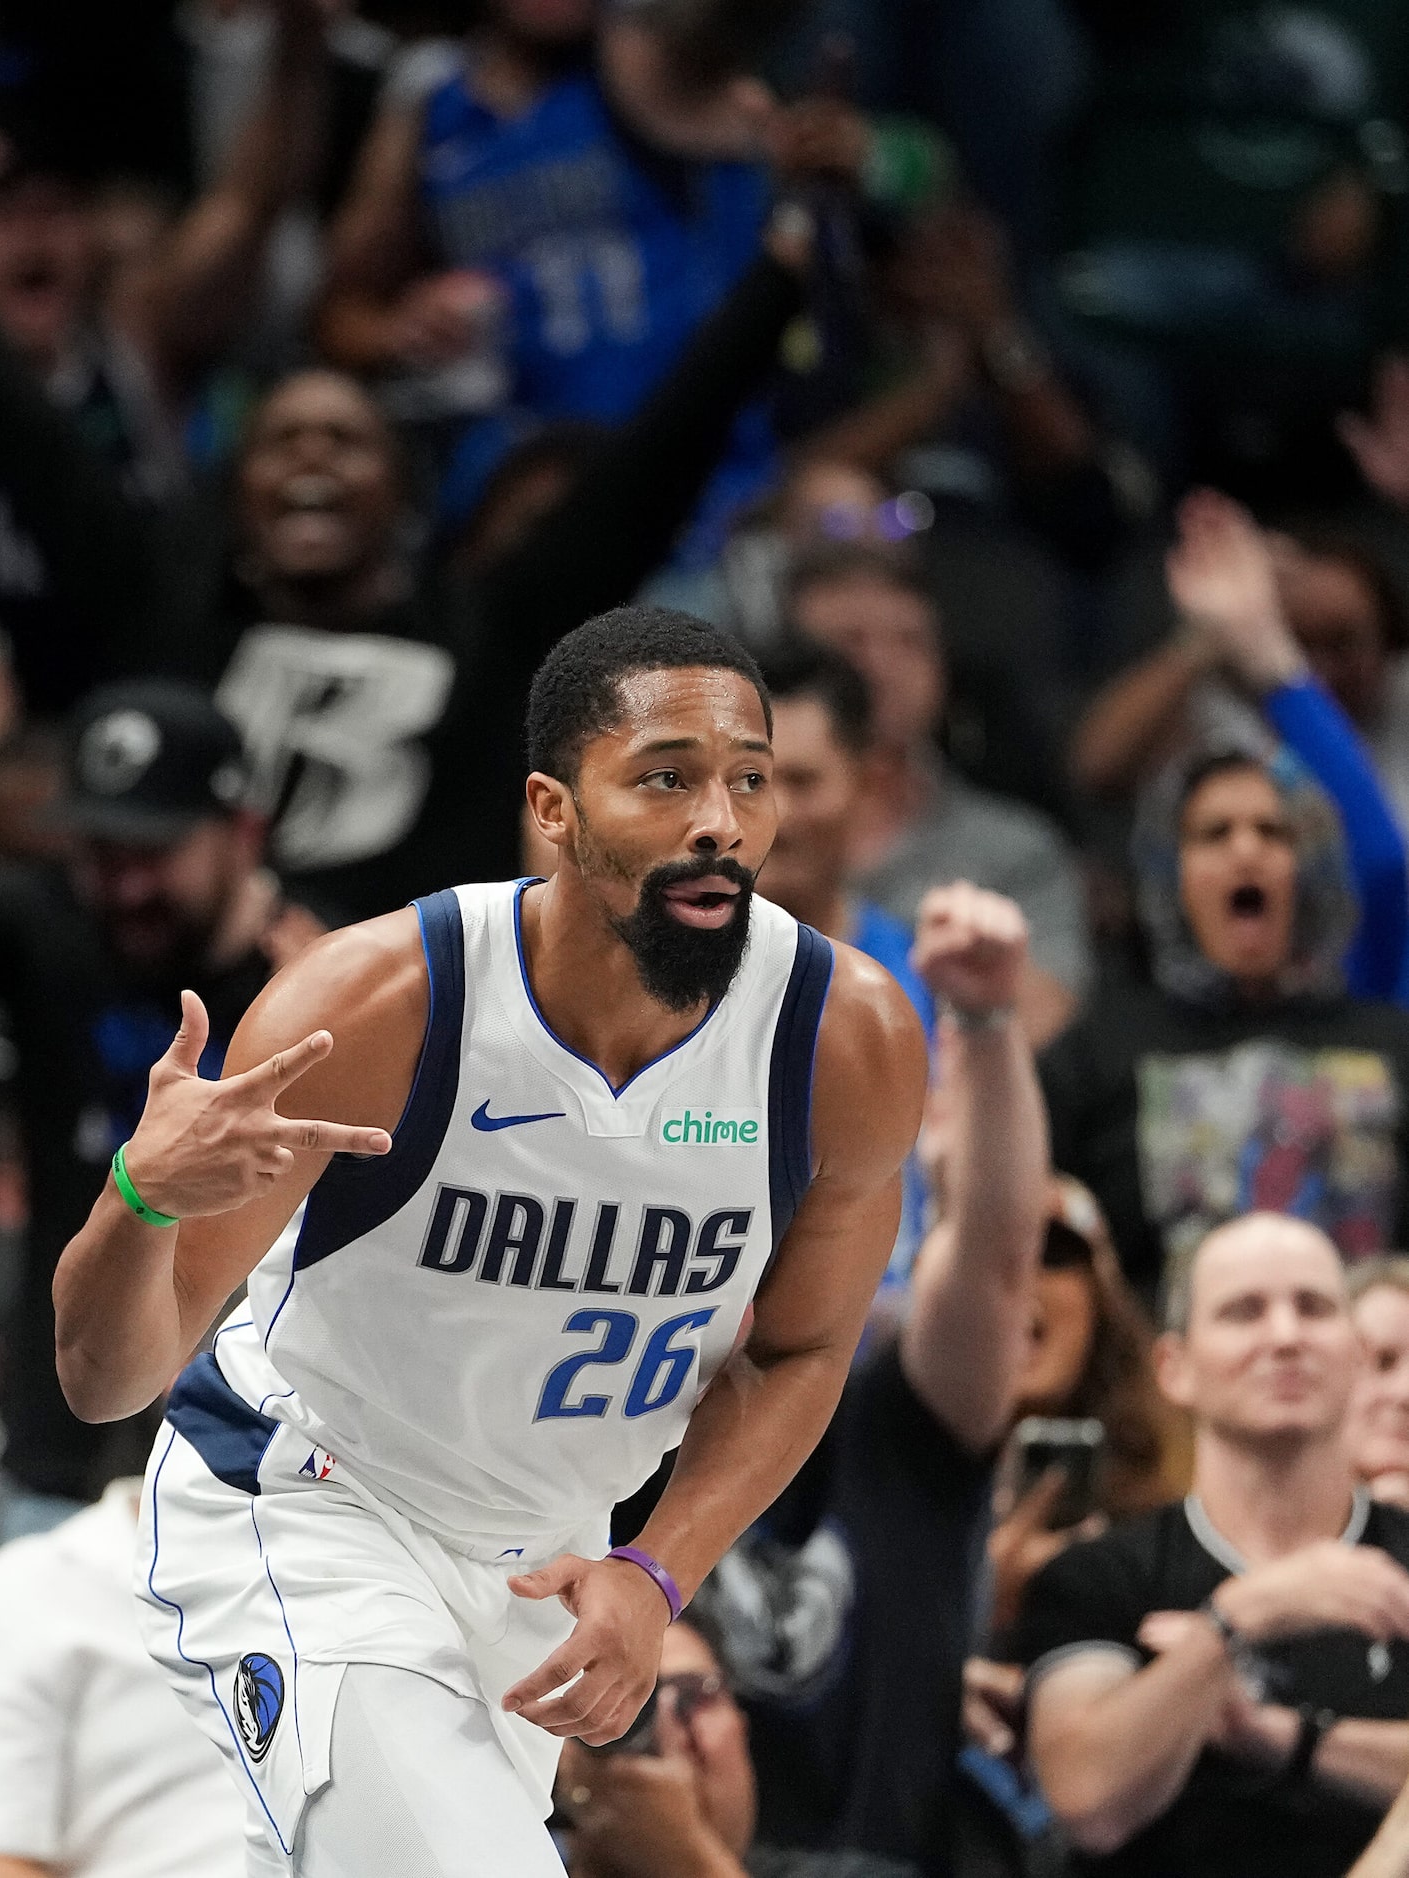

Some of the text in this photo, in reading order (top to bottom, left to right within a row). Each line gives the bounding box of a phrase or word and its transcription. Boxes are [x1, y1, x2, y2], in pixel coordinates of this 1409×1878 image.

[663, 1110, 758, 1143] chime
[417, 1182, 755, 1297] DALLAS
[532, 1306, 721, 1424] 26
